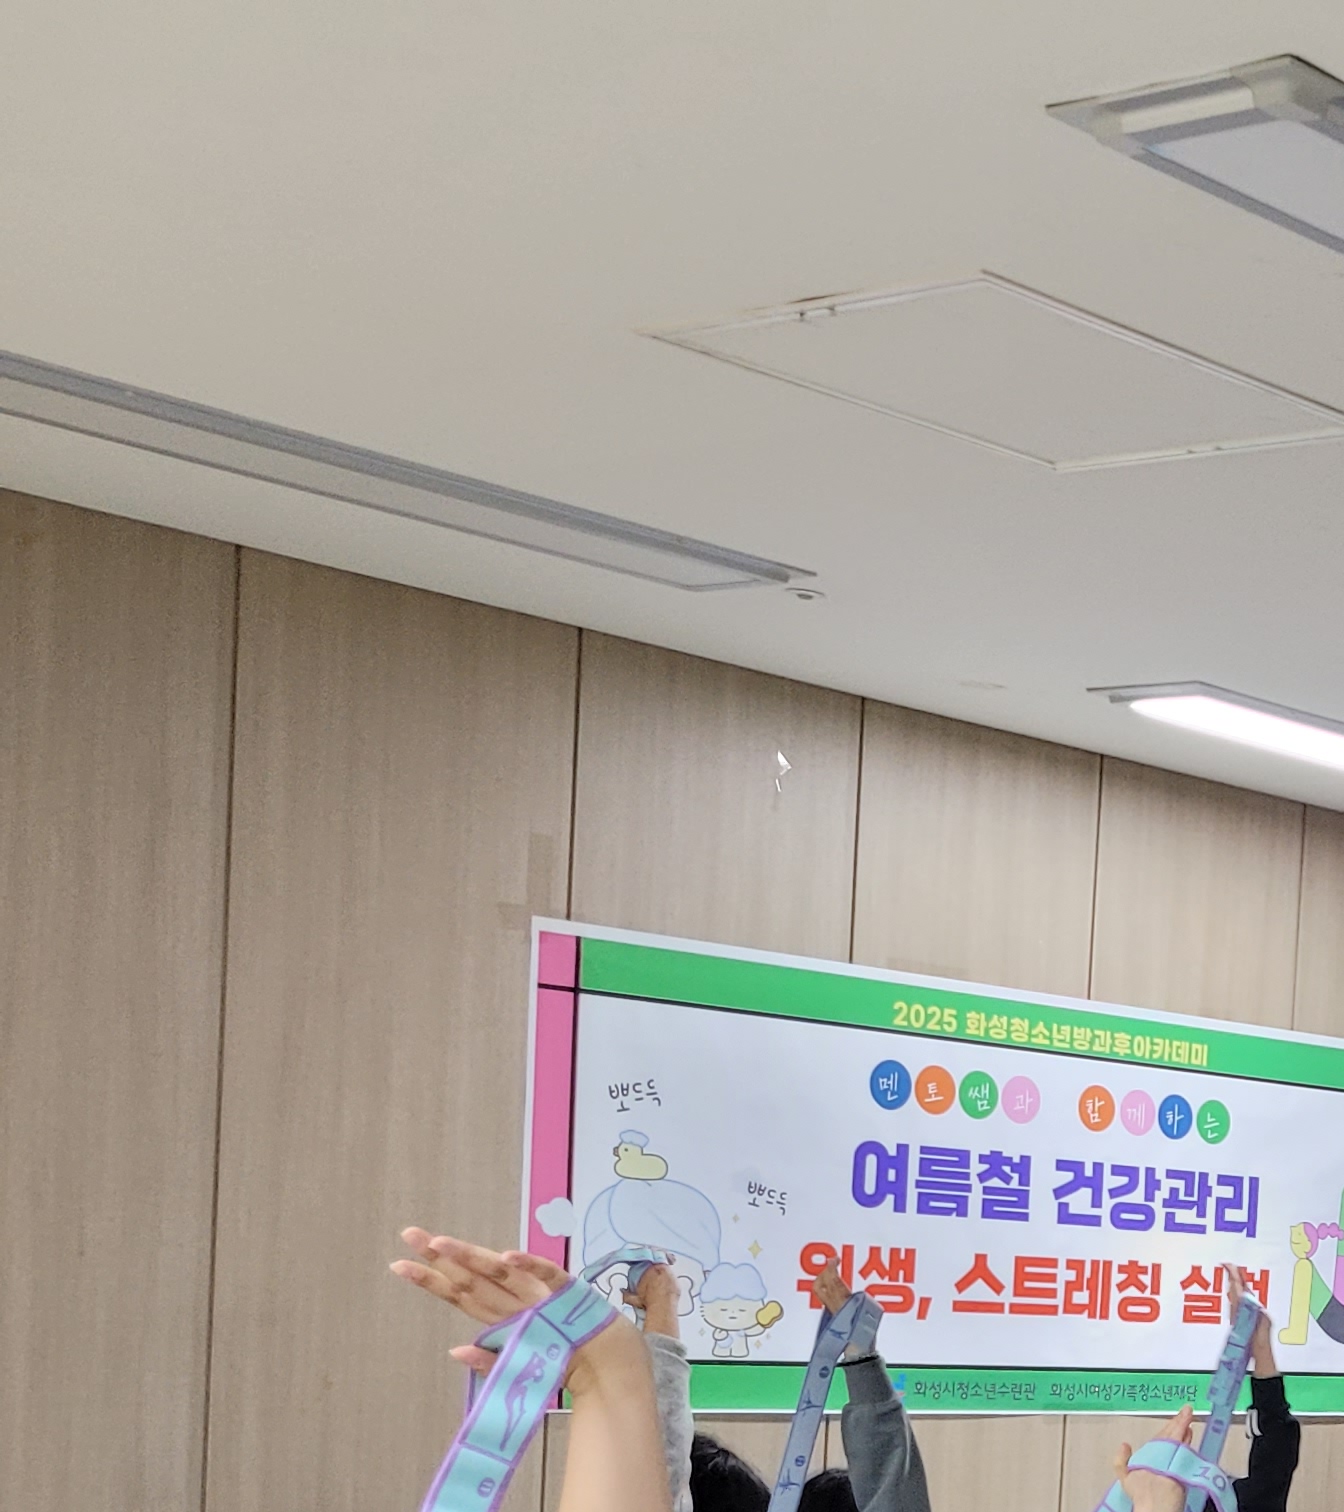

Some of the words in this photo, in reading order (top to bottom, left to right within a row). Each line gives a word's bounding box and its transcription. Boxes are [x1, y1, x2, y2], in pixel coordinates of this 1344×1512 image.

[892, 1001, 958, 1032] 2025
[965, 1010, 1209, 1067] 화성청소년방과후아카데미
[608, 1078, 662, 1113] 뽀드득
[877, 1071, 1034, 1114] 멘토쌤과
[1084, 1095, 1221, 1138] 함께하는
[747, 1180, 788, 1216] 뽀드득
[850, 1139, 1032, 1222] 여름철
[1051, 1157, 1261, 1240] 건강관리
[951, 1252, 1163, 1323] 스트레칭
